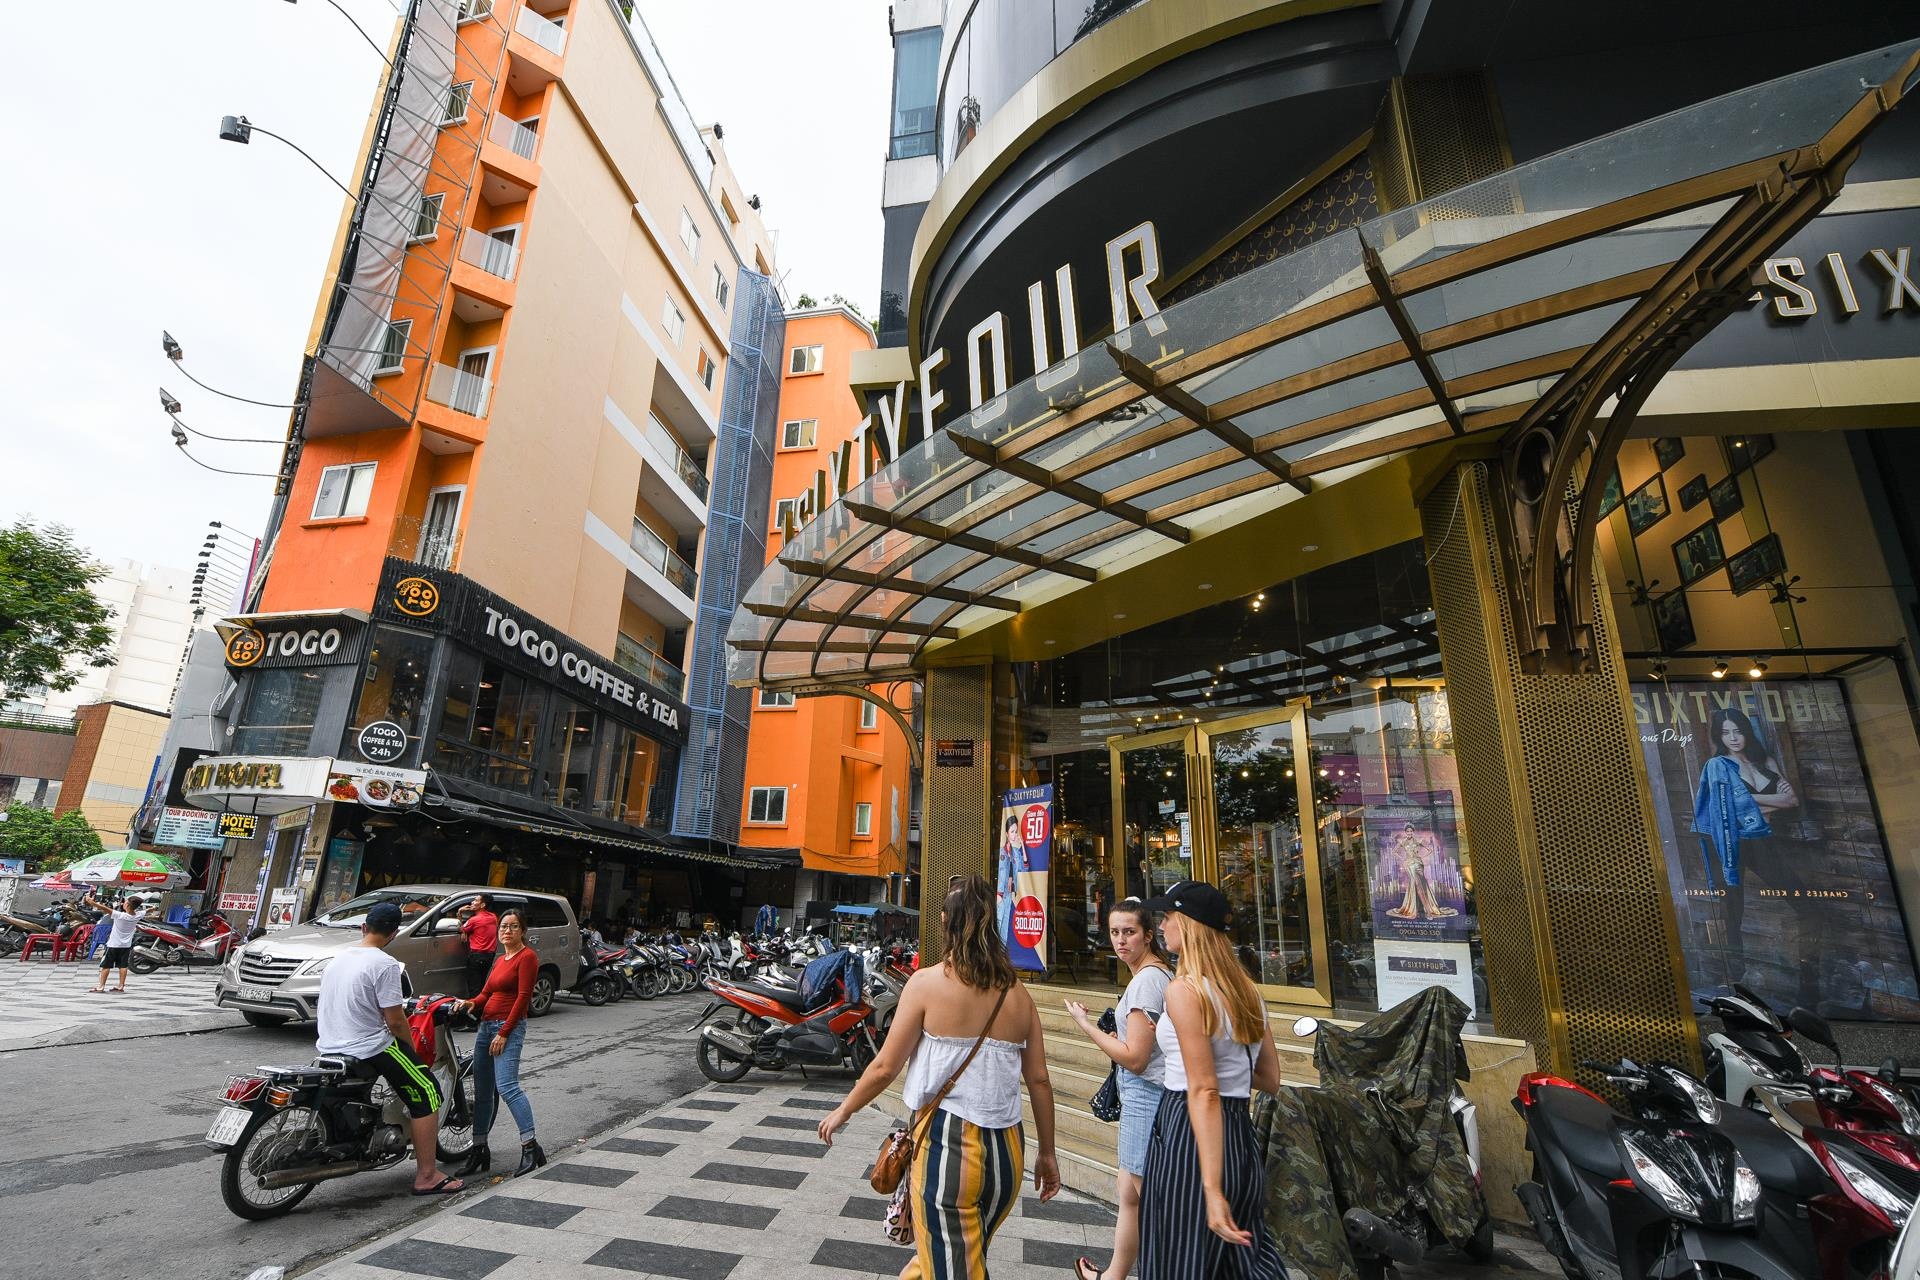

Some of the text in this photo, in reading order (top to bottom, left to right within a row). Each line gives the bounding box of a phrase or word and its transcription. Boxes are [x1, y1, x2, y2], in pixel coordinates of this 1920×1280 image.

[266, 627, 341, 657] TOGO
[485, 606, 679, 730] TOGO COFFEE & TEA
[373, 727, 397, 737] TOGO
[362, 736, 384, 746] COFFEE
[392, 740, 403, 748] TEA
[370, 747, 391, 757] 24h
[215, 762, 282, 789] HOTEL
[182, 810, 208, 819] BOOKING
[221, 816, 255, 829] HOTEL
[1026, 817, 1044, 840] 50
